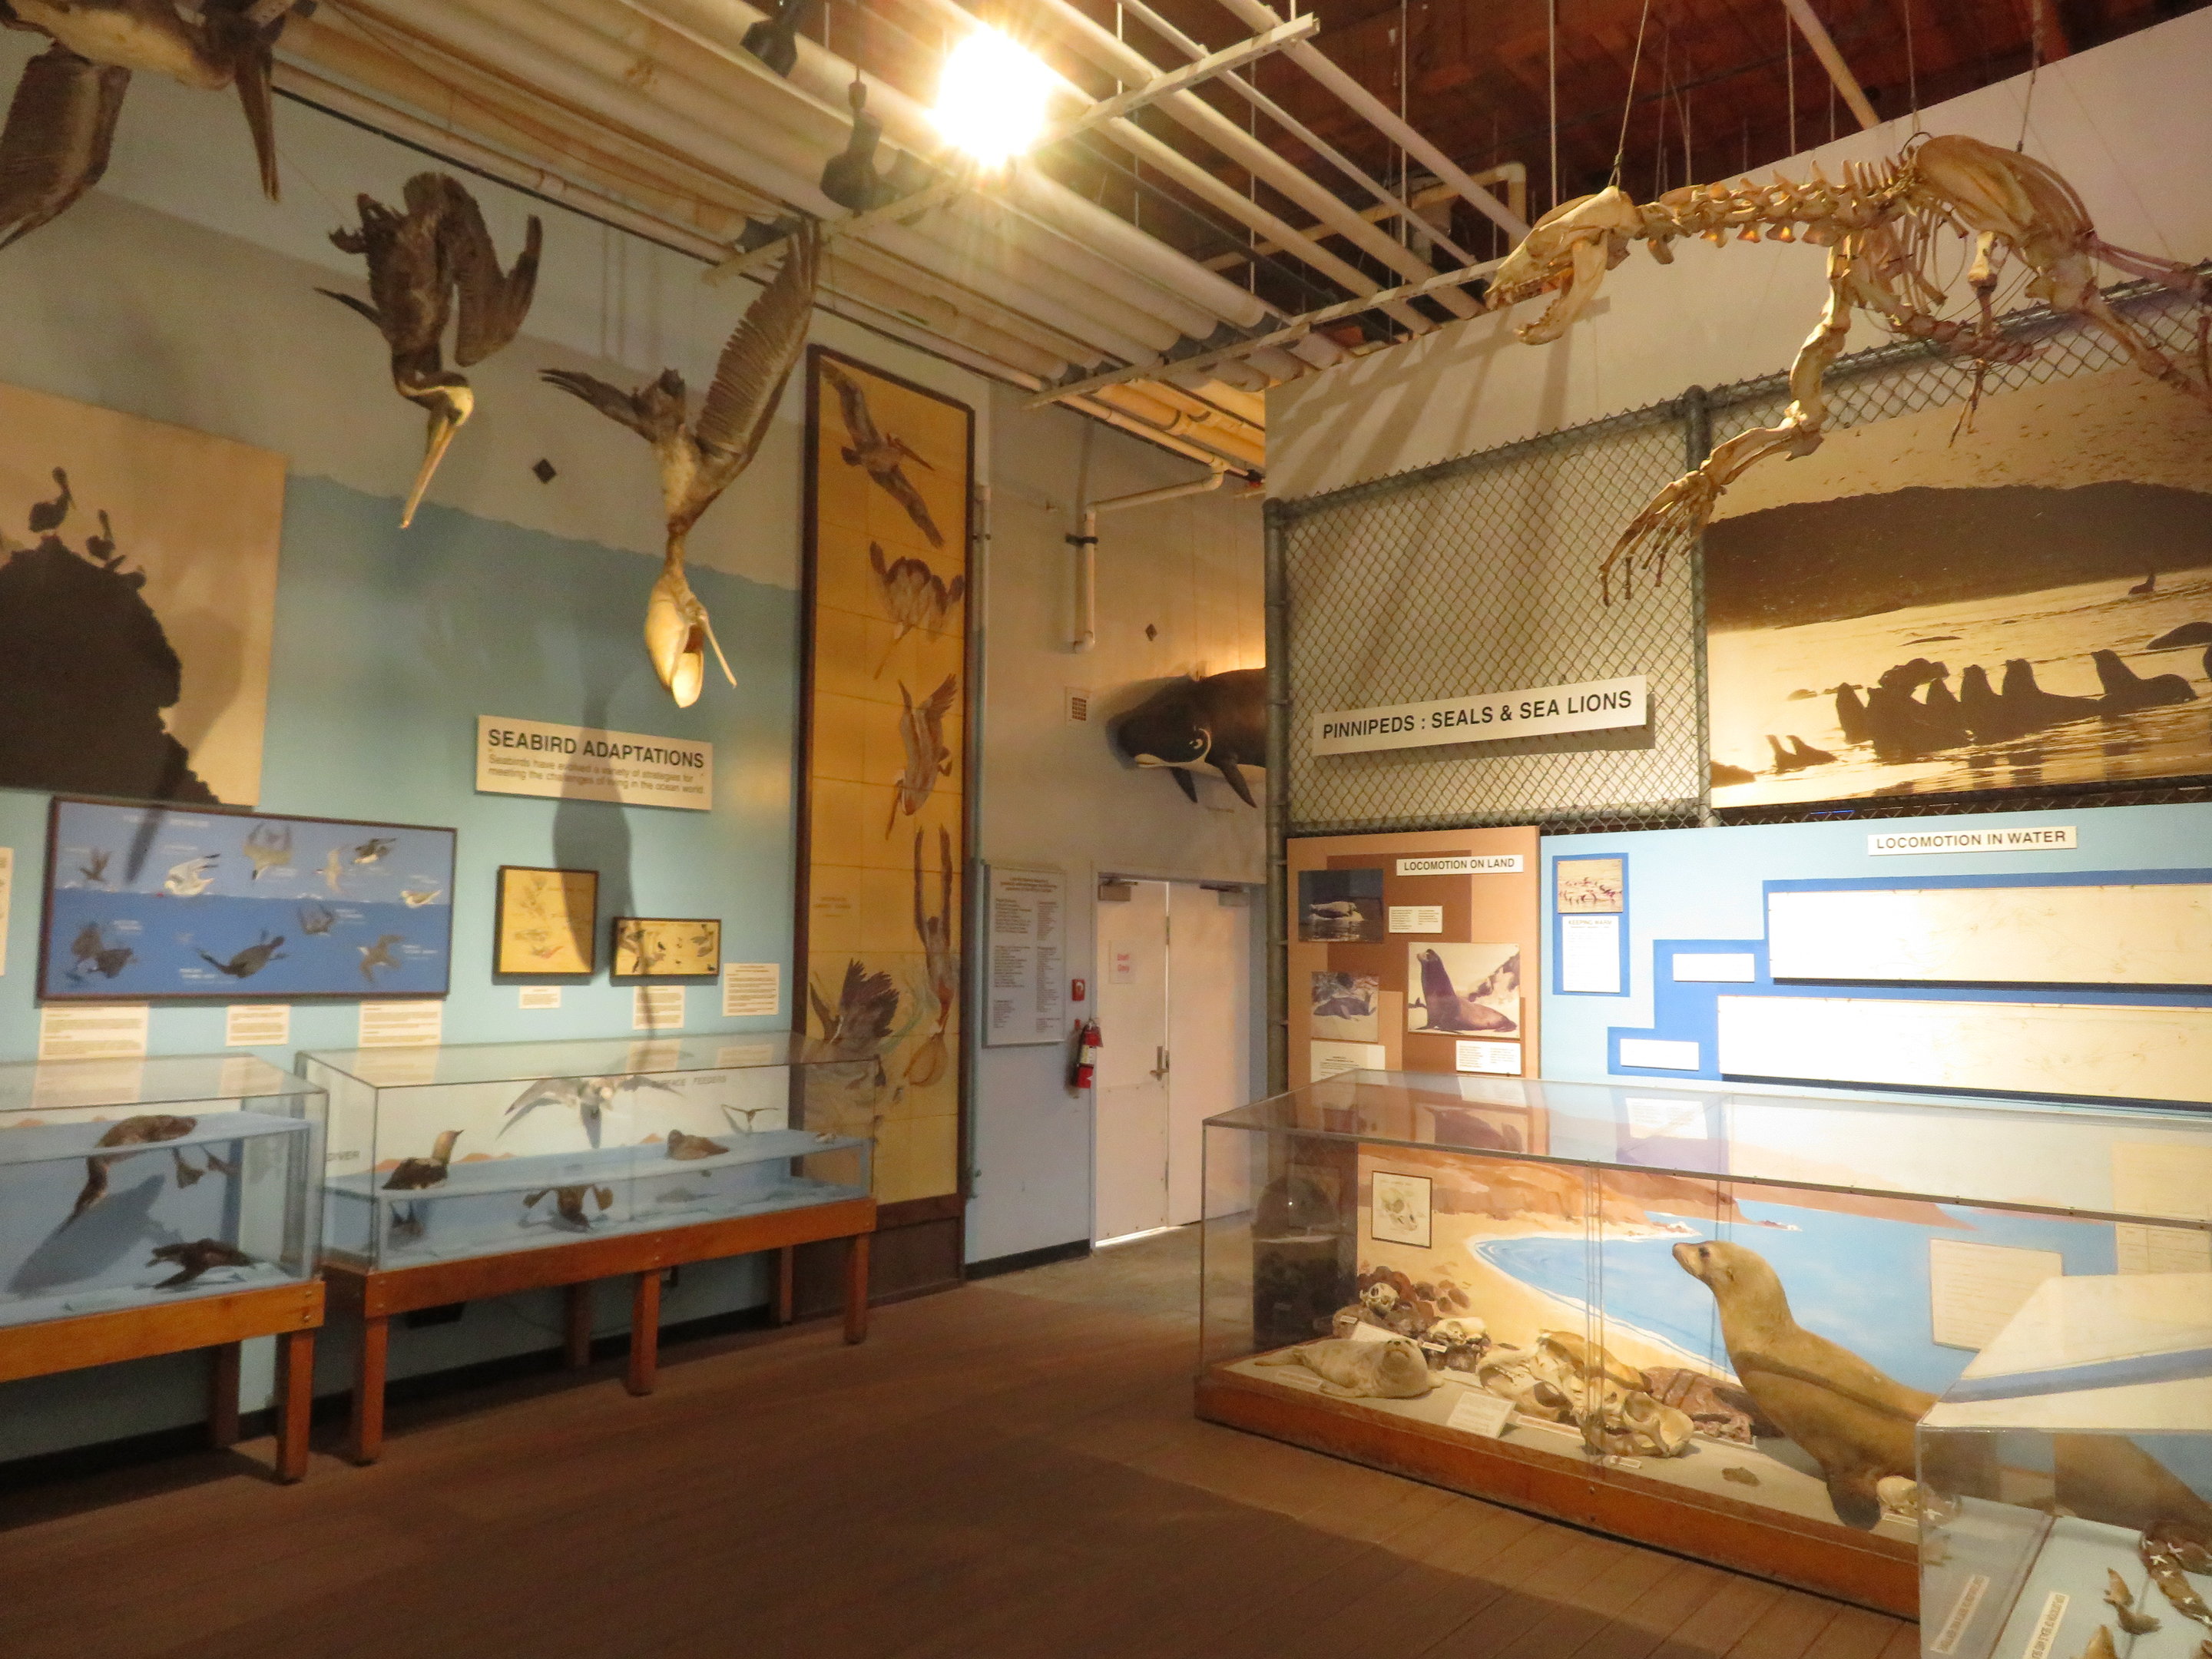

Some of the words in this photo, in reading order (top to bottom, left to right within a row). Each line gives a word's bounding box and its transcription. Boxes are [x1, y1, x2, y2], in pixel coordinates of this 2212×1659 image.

[1323, 715, 1415, 739] PINNIPEDS
[1432, 706, 1493, 729] SEALS
[1500, 704, 1512, 721] &
[1520, 700, 1560, 719] SEA
[1568, 690, 1632, 715] LIONS
[488, 729, 577, 754] SEABIRD
[583, 740, 704, 768] ADAPTATIONS
[1877, 834, 1982, 849] LOCOMOTION
[1988, 833, 2002, 844] IN
[2008, 830, 2066, 843] WATER
[1404, 860, 1467, 871] LOCOMOTION
[1470, 859, 1485, 869] ON
[1488, 858, 1515, 868] LAND
